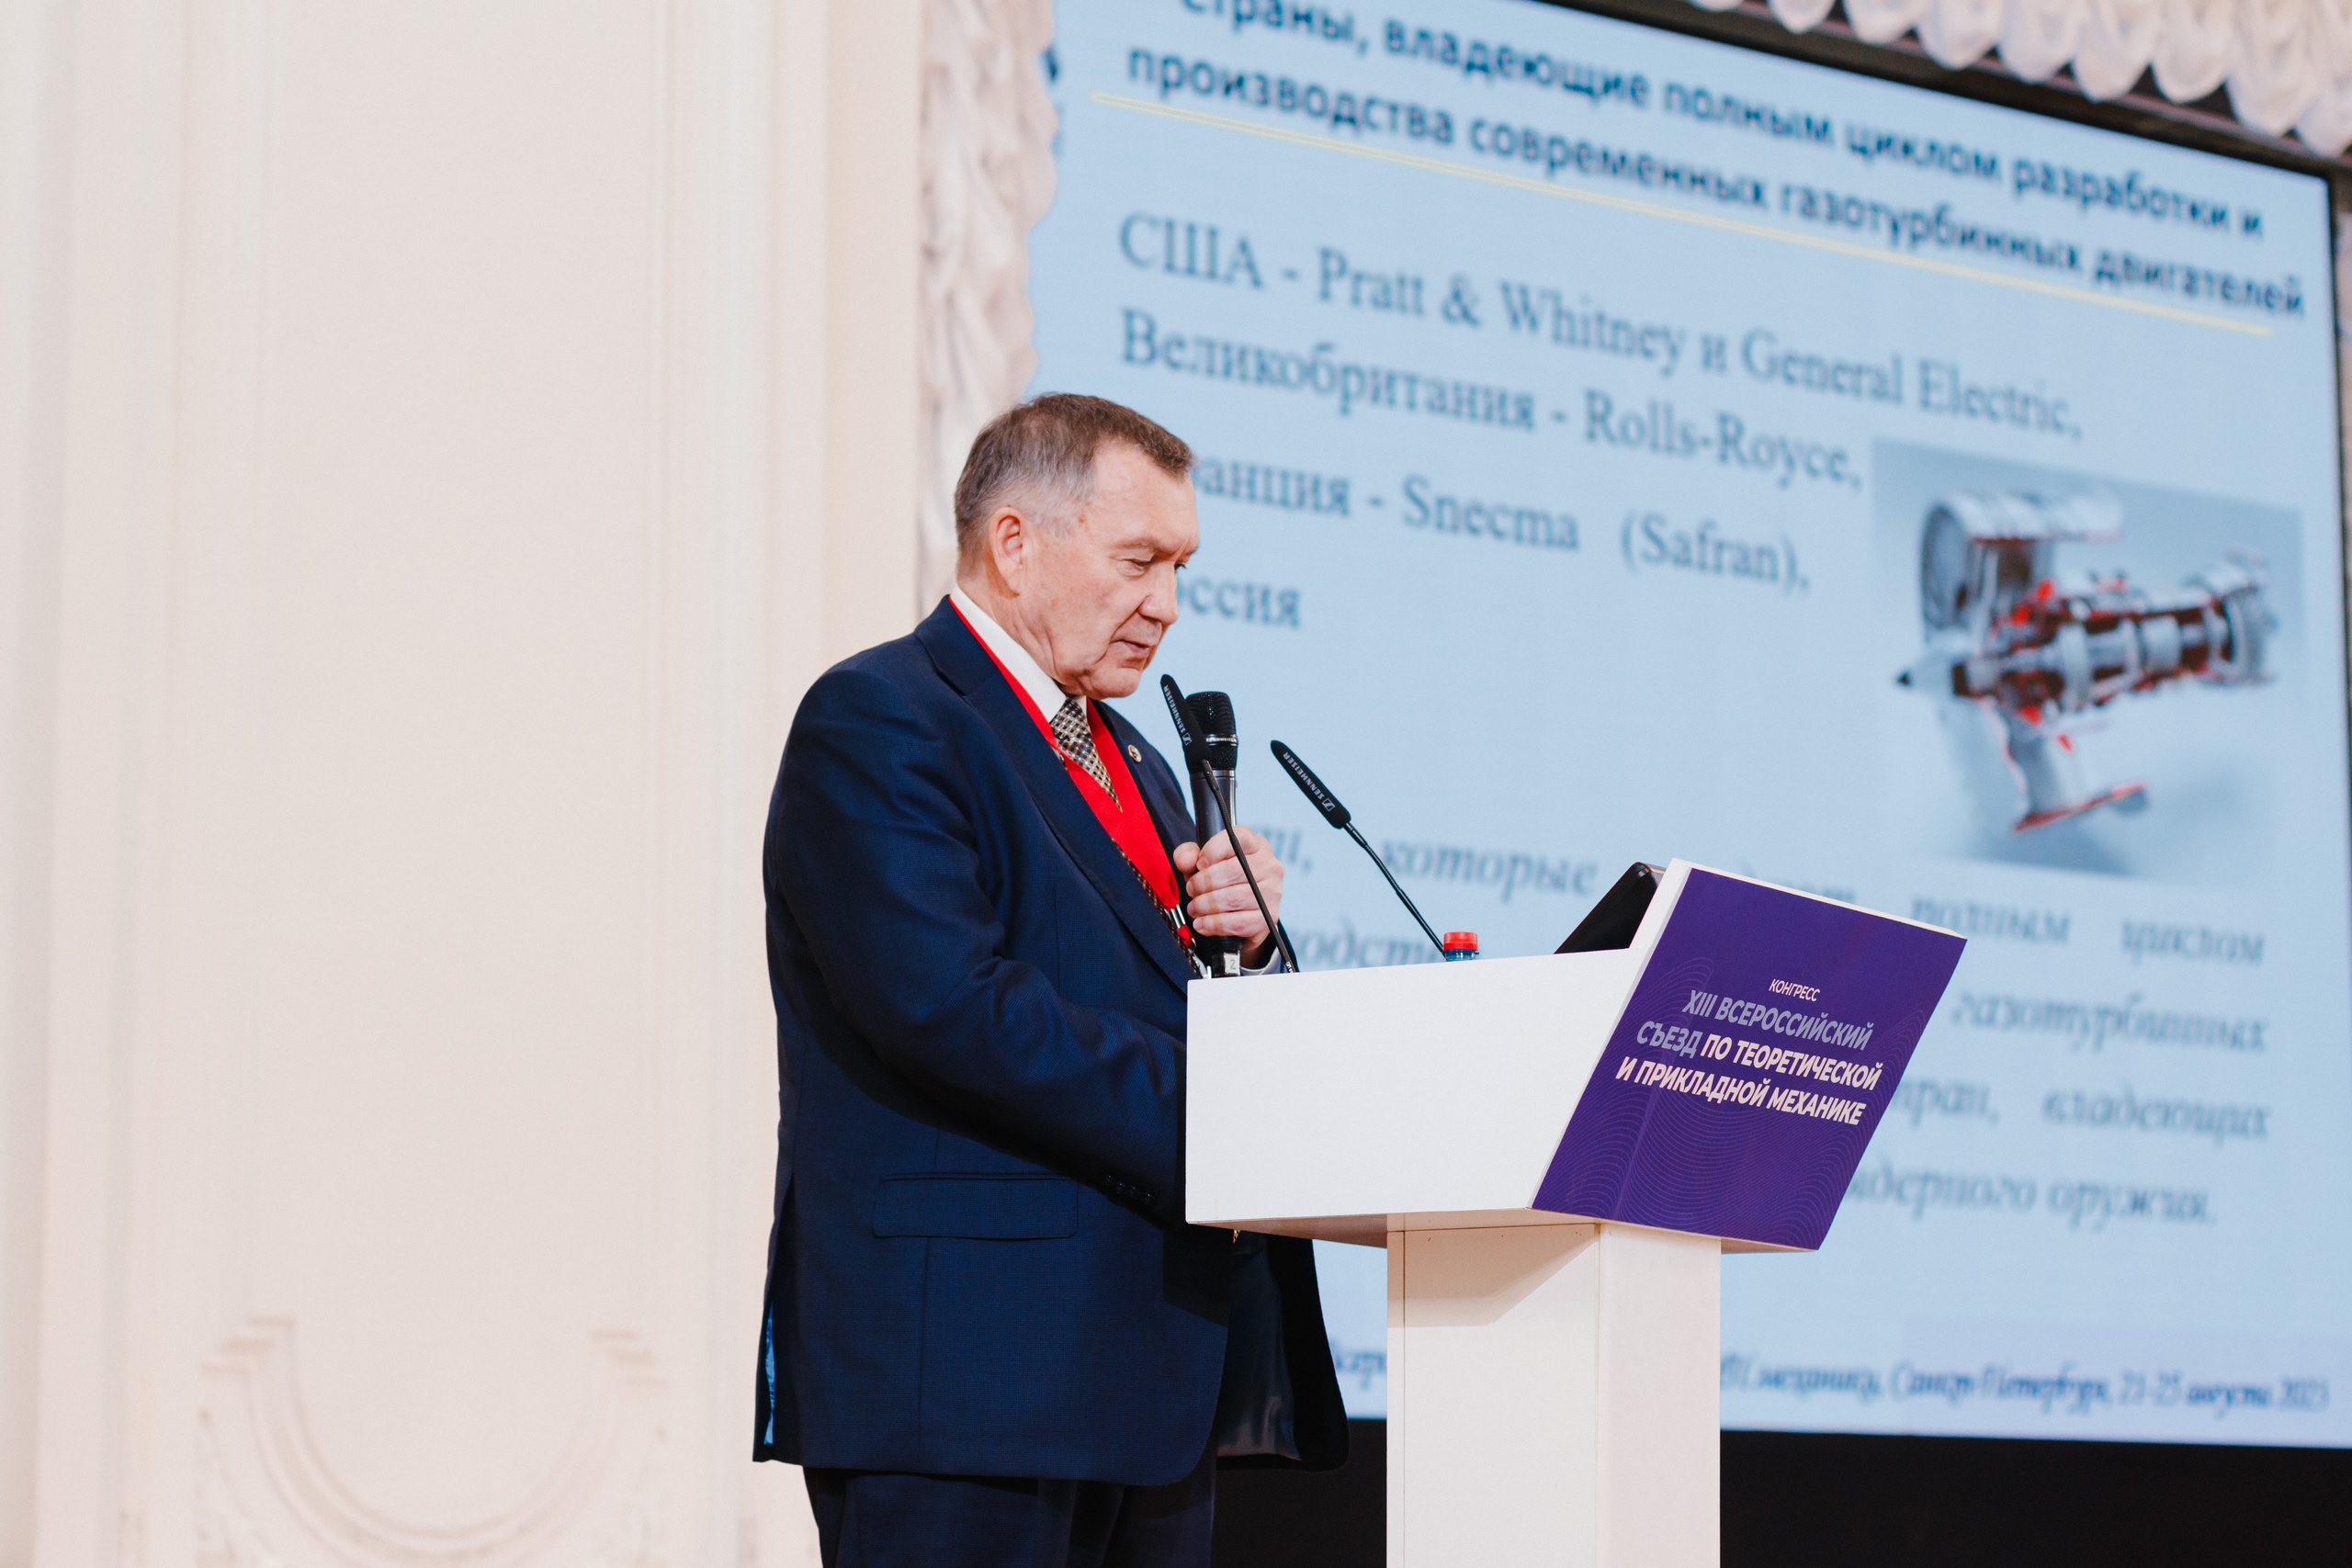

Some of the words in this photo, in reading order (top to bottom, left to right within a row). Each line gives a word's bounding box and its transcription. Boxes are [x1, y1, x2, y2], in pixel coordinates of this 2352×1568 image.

[1385, 20, 1649, 107] владеющие
[1665, 83, 1833, 144] полным
[1848, 129, 1999, 178] циклом
[2013, 158, 2229, 229] разработки
[2242, 211, 2263, 237] и
[1128, 49, 1454, 146] производства
[1470, 118, 1767, 209] современных
[1781, 185, 2082, 272] газотурбинных
[2093, 250, 2304, 315] двигателей
[1119, 213, 1264, 289] США
[1318, 246, 1425, 318] Pratt
[1442, 275, 1481, 328] &
[1498, 280, 1686, 378] Whitney
[1701, 334, 1726, 373] и
[1740, 329, 1904, 406] General
[1917, 358, 2082, 440] Electric,
[1122, 308, 1535, 432] Великобритания
[1584, 389, 1861, 490] Rolls-Royce,
[1193, 458, 1351, 517] анция
[1402, 475, 1580, 551] Snecma
[1621, 513, 1809, 592] (Safran),
[1177, 578, 1300, 629] ссия
[1163, 684, 1186, 733] SENNHEISER
[1283, 751, 1325, 799] SENNHEISER
[1380, 838, 1600, 902] которые
[1909, 893, 2070, 946] полным
[2121, 920, 2266, 966] циклом
[1230, 959, 1236, 969] 2
[1769, 978, 1820, 1002] КОНГРЕСС
[1681, 989, 1718, 1016] XIII
[1714, 997, 1874, 1050] ВСЕРОССИЙСКИЙ
[1951, 991, 2268, 1054] газотурбинных
[1615, 1056, 1638, 1080] И
[1634, 1060, 1771, 1104] ПРИКЛАДНОЙ
[1766, 1087, 1867, 1125] МЕХАНИКЕ
[1636, 1021, 1703, 1059] СЪЕЗД
[1700, 1033, 1733, 1060] ПО
[1733, 1040, 1883, 1091] ТЕОРЕТИЧЕСКОЙ
[1888, 1075, 1998, 1127] тран,
[2042, 1085, 2271, 1146] владеющих
